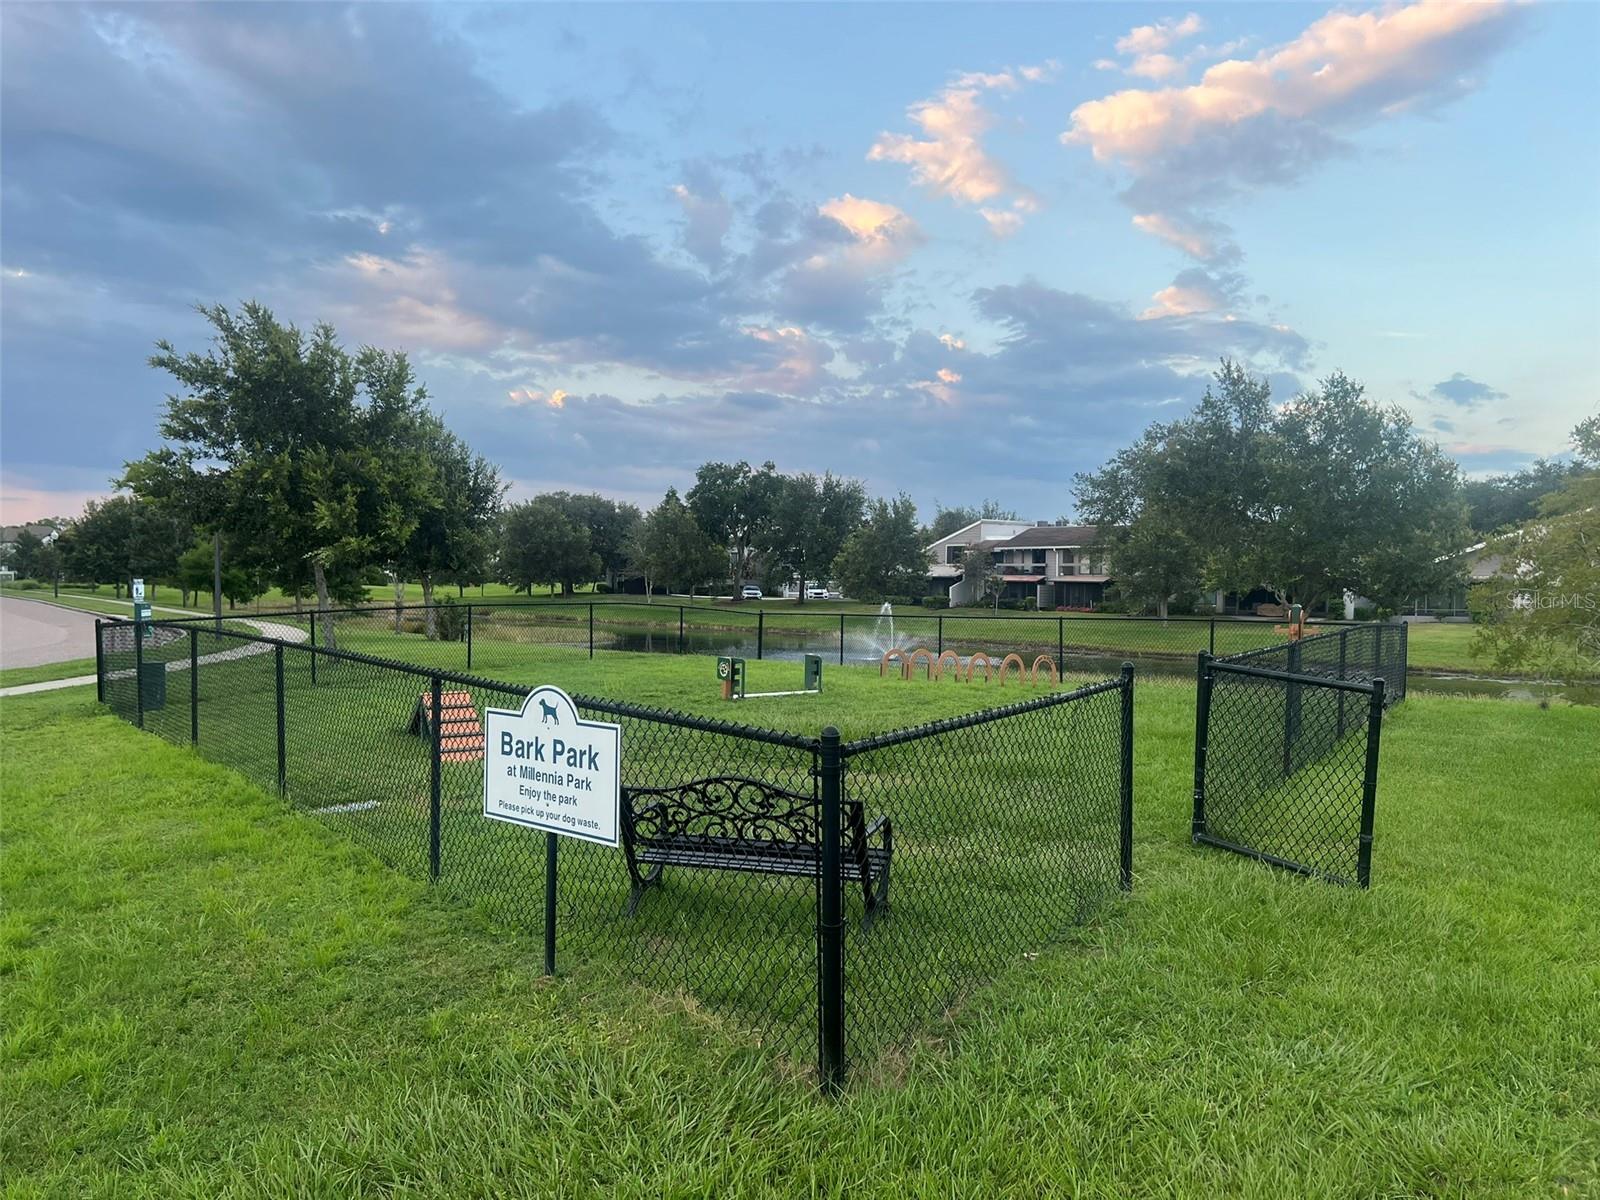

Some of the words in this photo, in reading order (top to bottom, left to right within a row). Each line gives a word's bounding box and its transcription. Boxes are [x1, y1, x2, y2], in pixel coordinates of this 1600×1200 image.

[501, 731, 545, 762] Bark
[552, 739, 599, 771] Park
[507, 766, 517, 777] at
[519, 765, 564, 786] Millennia
[566, 773, 592, 792] Park
[519, 785, 541, 801] Enjoy
[543, 790, 557, 802] the
[558, 795, 578, 807] park
[498, 800, 520, 812] Please
[521, 804, 534, 815] pick
[535, 810, 545, 818] up
[545, 810, 561, 821] your
[562, 813, 576, 826] dog
[577, 817, 601, 831] waste.
